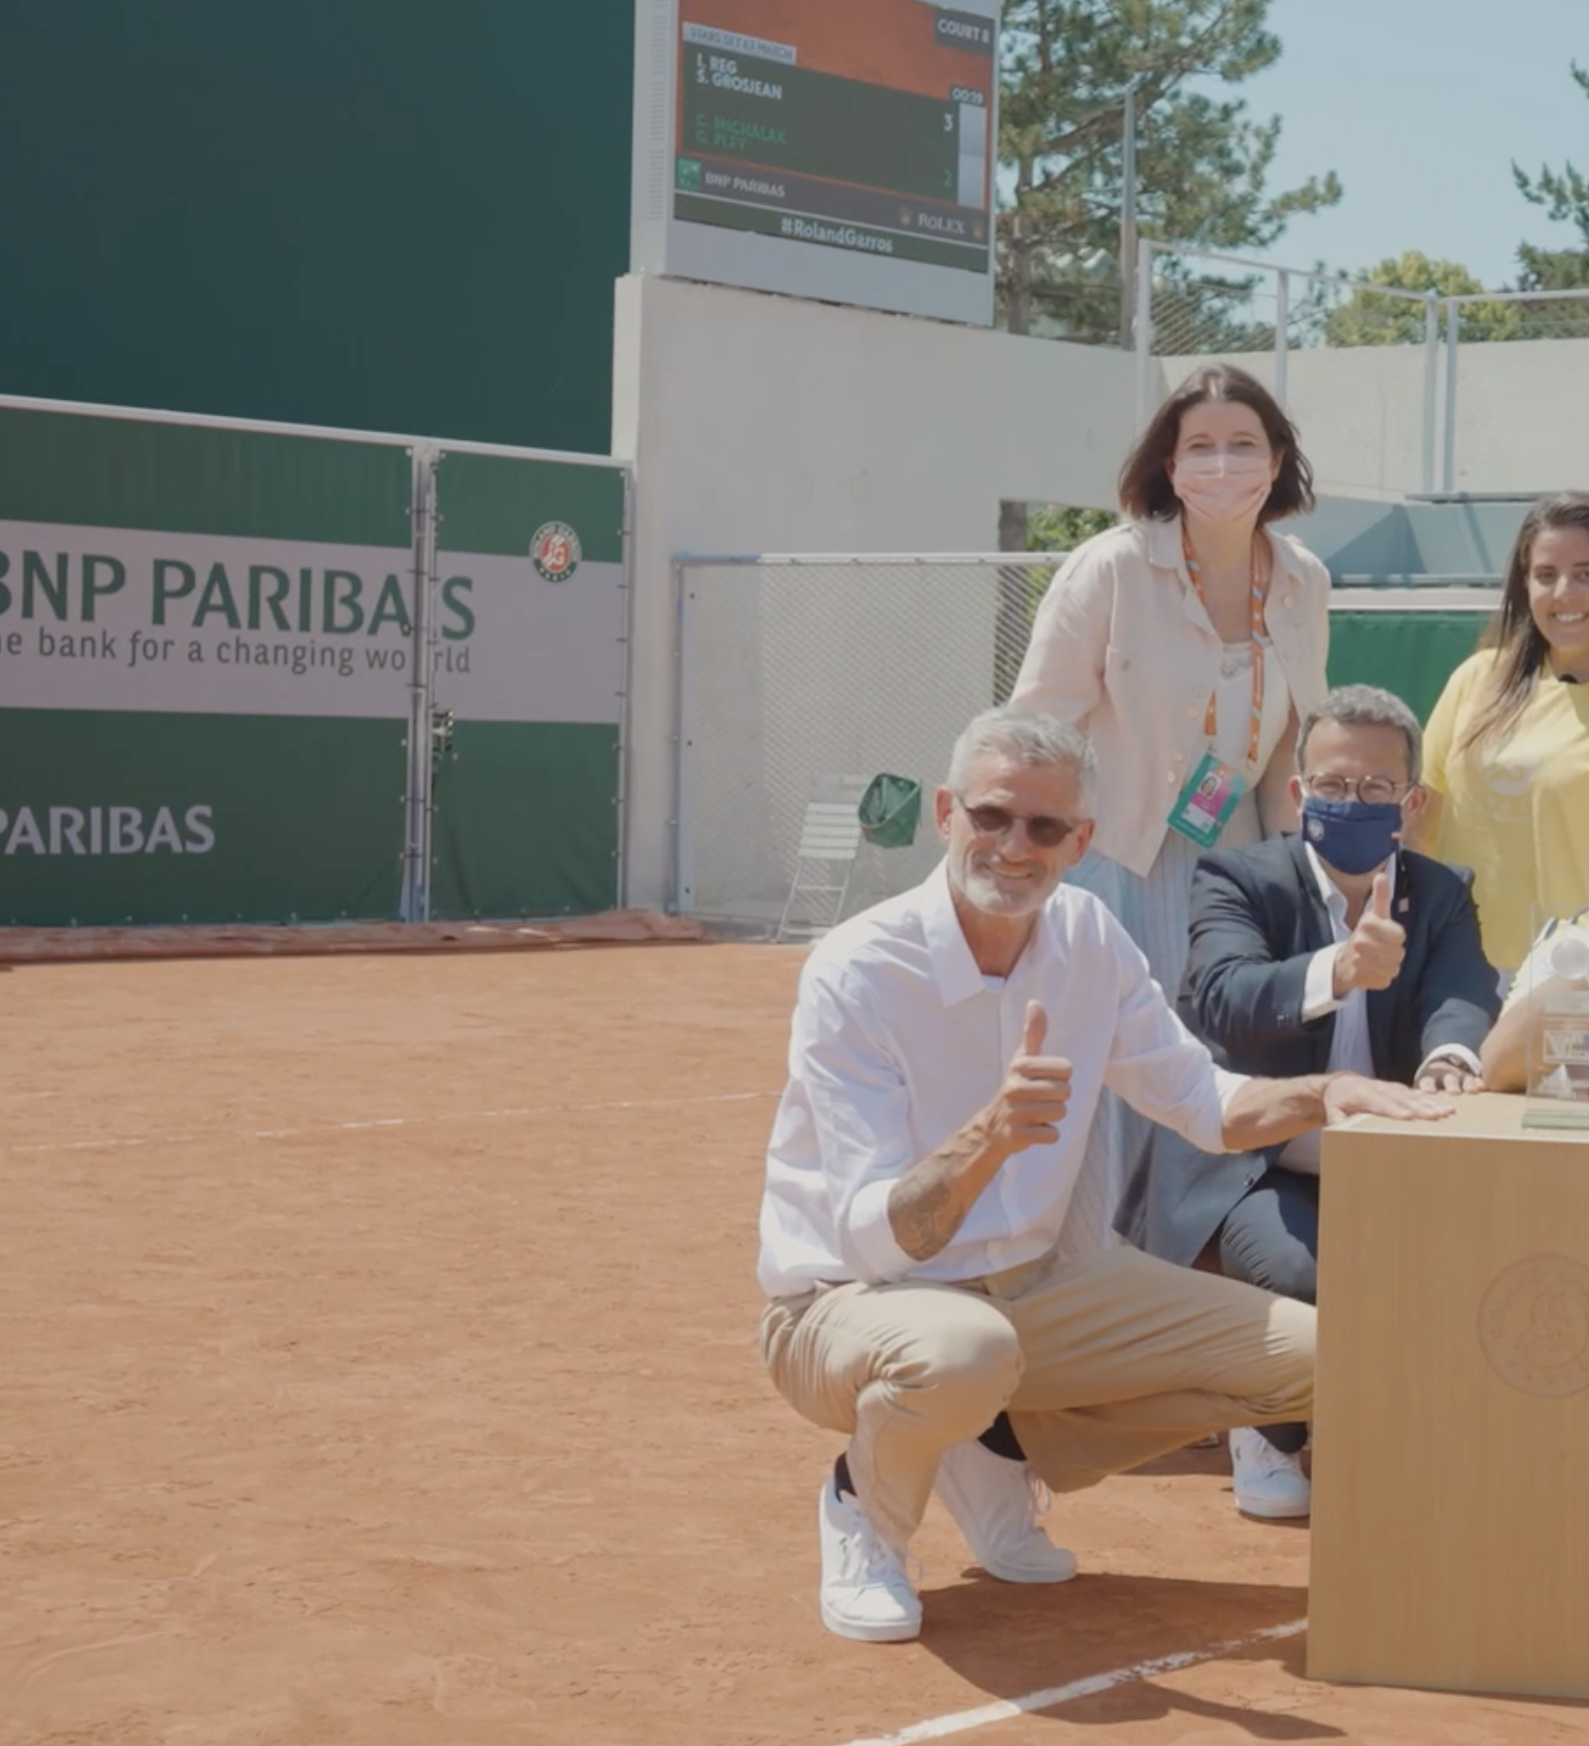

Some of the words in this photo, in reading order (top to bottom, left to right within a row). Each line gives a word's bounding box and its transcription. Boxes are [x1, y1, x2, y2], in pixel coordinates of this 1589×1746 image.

[938, 18, 980, 42] COURT
[710, 56, 738, 75] REG
[697, 68, 709, 84] S.
[712, 73, 783, 100] GROSJEAN
[714, 116, 787, 144] MICHALAK
[943, 115, 953, 132] 3
[705, 172, 730, 187] BNP
[733, 176, 786, 198] PARIBAS
[781, 216, 893, 252] #RolandGarros
[917, 213, 966, 234] ROLEX
[151, 557, 476, 642] PARIBAS
[38, 626, 118, 661] bank
[128, 629, 175, 667] for
[187, 640, 205, 663] a
[216, 634, 354, 676] changing
[365, 645, 471, 674] world
